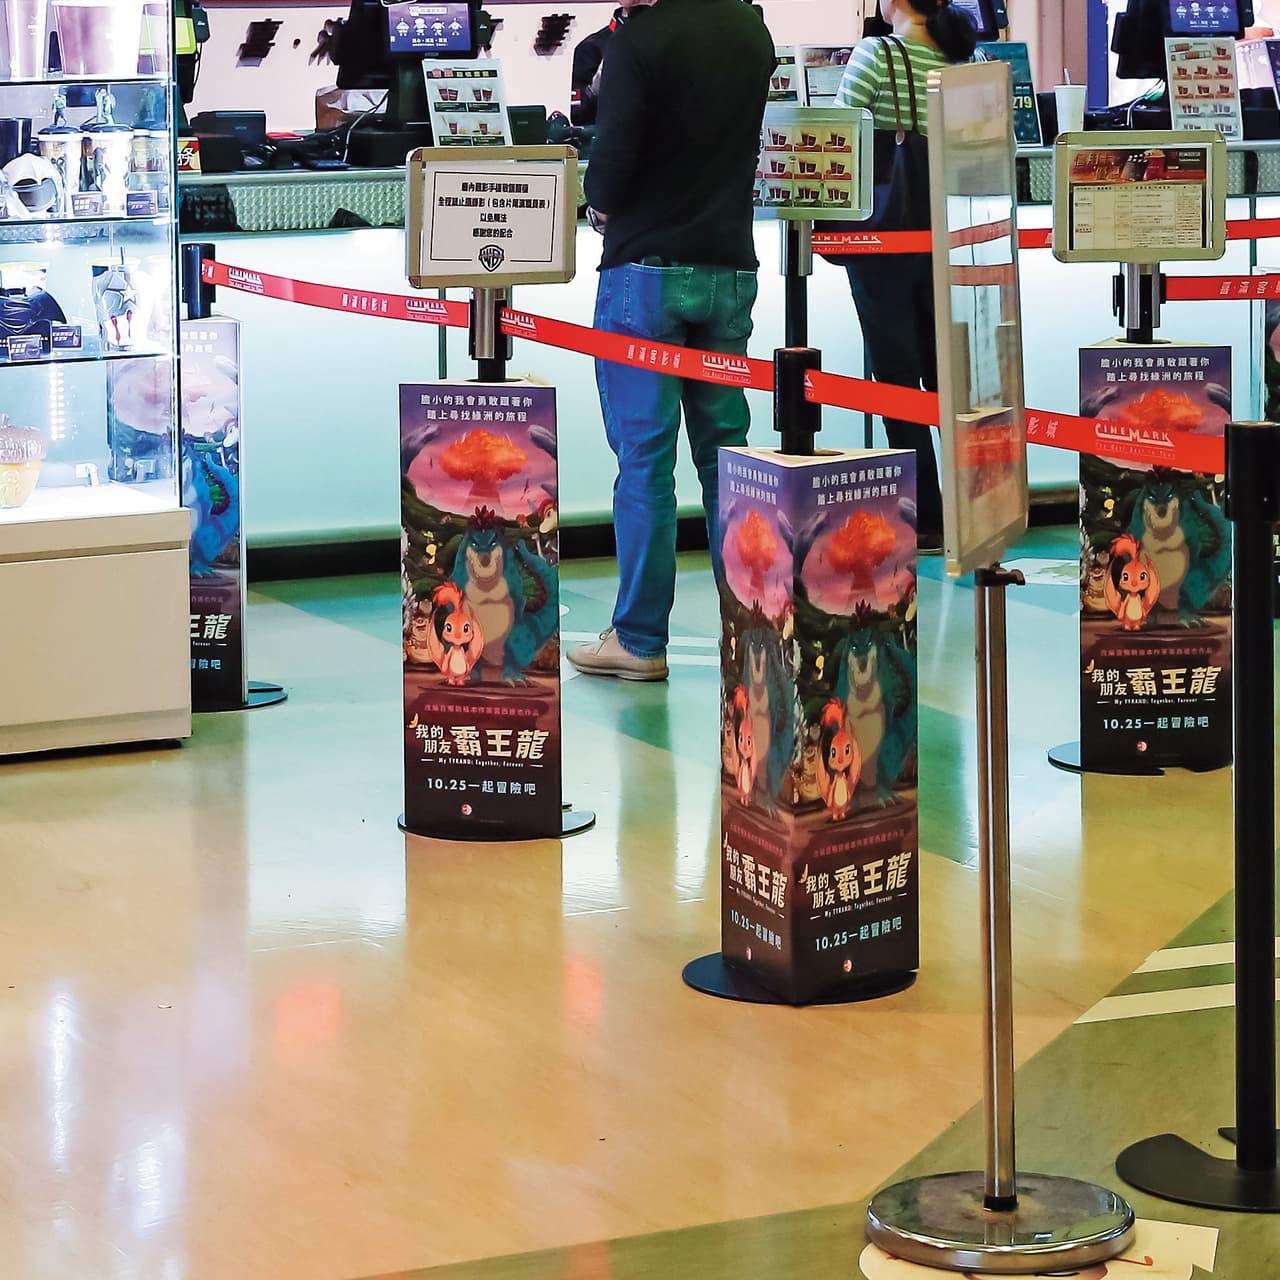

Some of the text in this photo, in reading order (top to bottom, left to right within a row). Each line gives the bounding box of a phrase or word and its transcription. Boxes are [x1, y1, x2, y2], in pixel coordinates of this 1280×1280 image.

[405, 299, 448, 316] CINEMARK
[702, 353, 752, 374] CINEMARK
[1095, 423, 1175, 447] CINEMARK
[1091, 668, 1120, 683] 我的
[1125, 665, 1222, 696] 霸王龍
[1100, 682, 1128, 696] 朋友
[415, 723, 444, 740] 我的
[1103, 716, 1209, 730] 10.25一起冒險吧
[424, 739, 452, 755] 朋友
[449, 725, 550, 760] 霸王龍
[426, 777, 537, 796] 10.25一起冒險吧
[741, 852, 788, 909] 霸王龍
[806, 872, 829, 894] 我的
[834, 851, 912, 902] 霸王龍
[812, 887, 836, 909] 朋友
[815, 916, 902, 952] 10.25一起冒險吧
